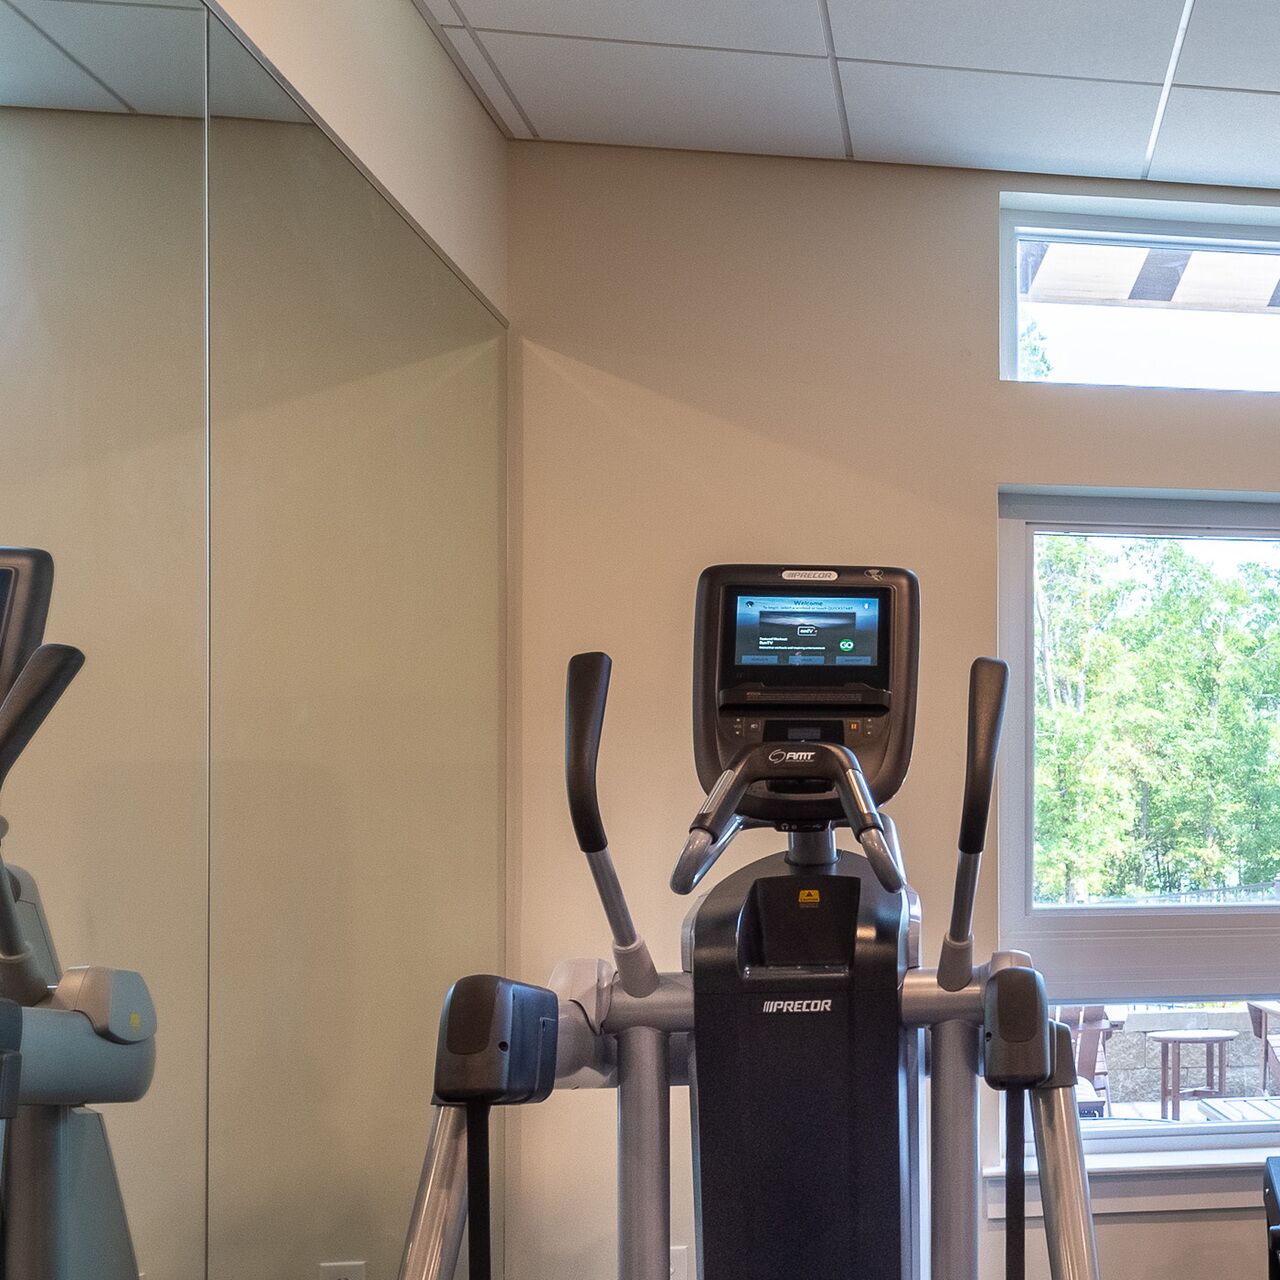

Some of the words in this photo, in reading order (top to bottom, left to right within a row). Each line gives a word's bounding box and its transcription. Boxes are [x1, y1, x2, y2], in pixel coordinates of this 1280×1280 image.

[840, 641, 854, 649] GO
[786, 752, 815, 760] AMT
[773, 1000, 832, 1013] PRECOR
